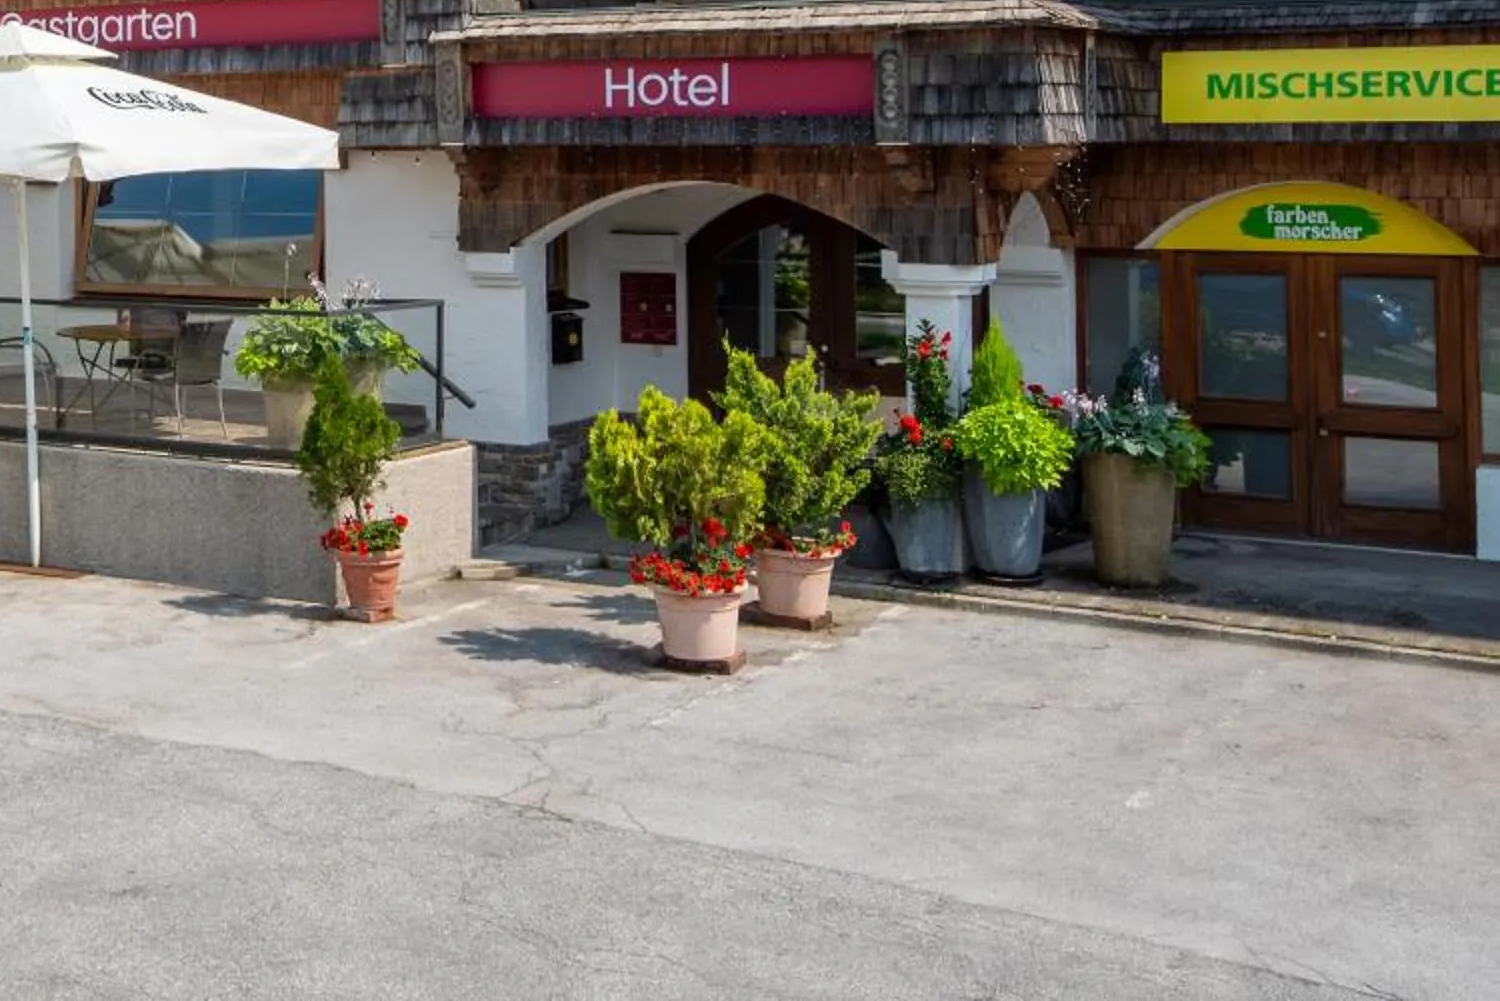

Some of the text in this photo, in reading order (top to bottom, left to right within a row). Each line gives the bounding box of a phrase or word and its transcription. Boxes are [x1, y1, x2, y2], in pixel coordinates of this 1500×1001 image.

[605, 62, 729, 108] Hotel
[1206, 68, 1500, 100] MISCHSERVICE
[1265, 203, 1329, 224] farben
[1273, 220, 1363, 240] morscher
